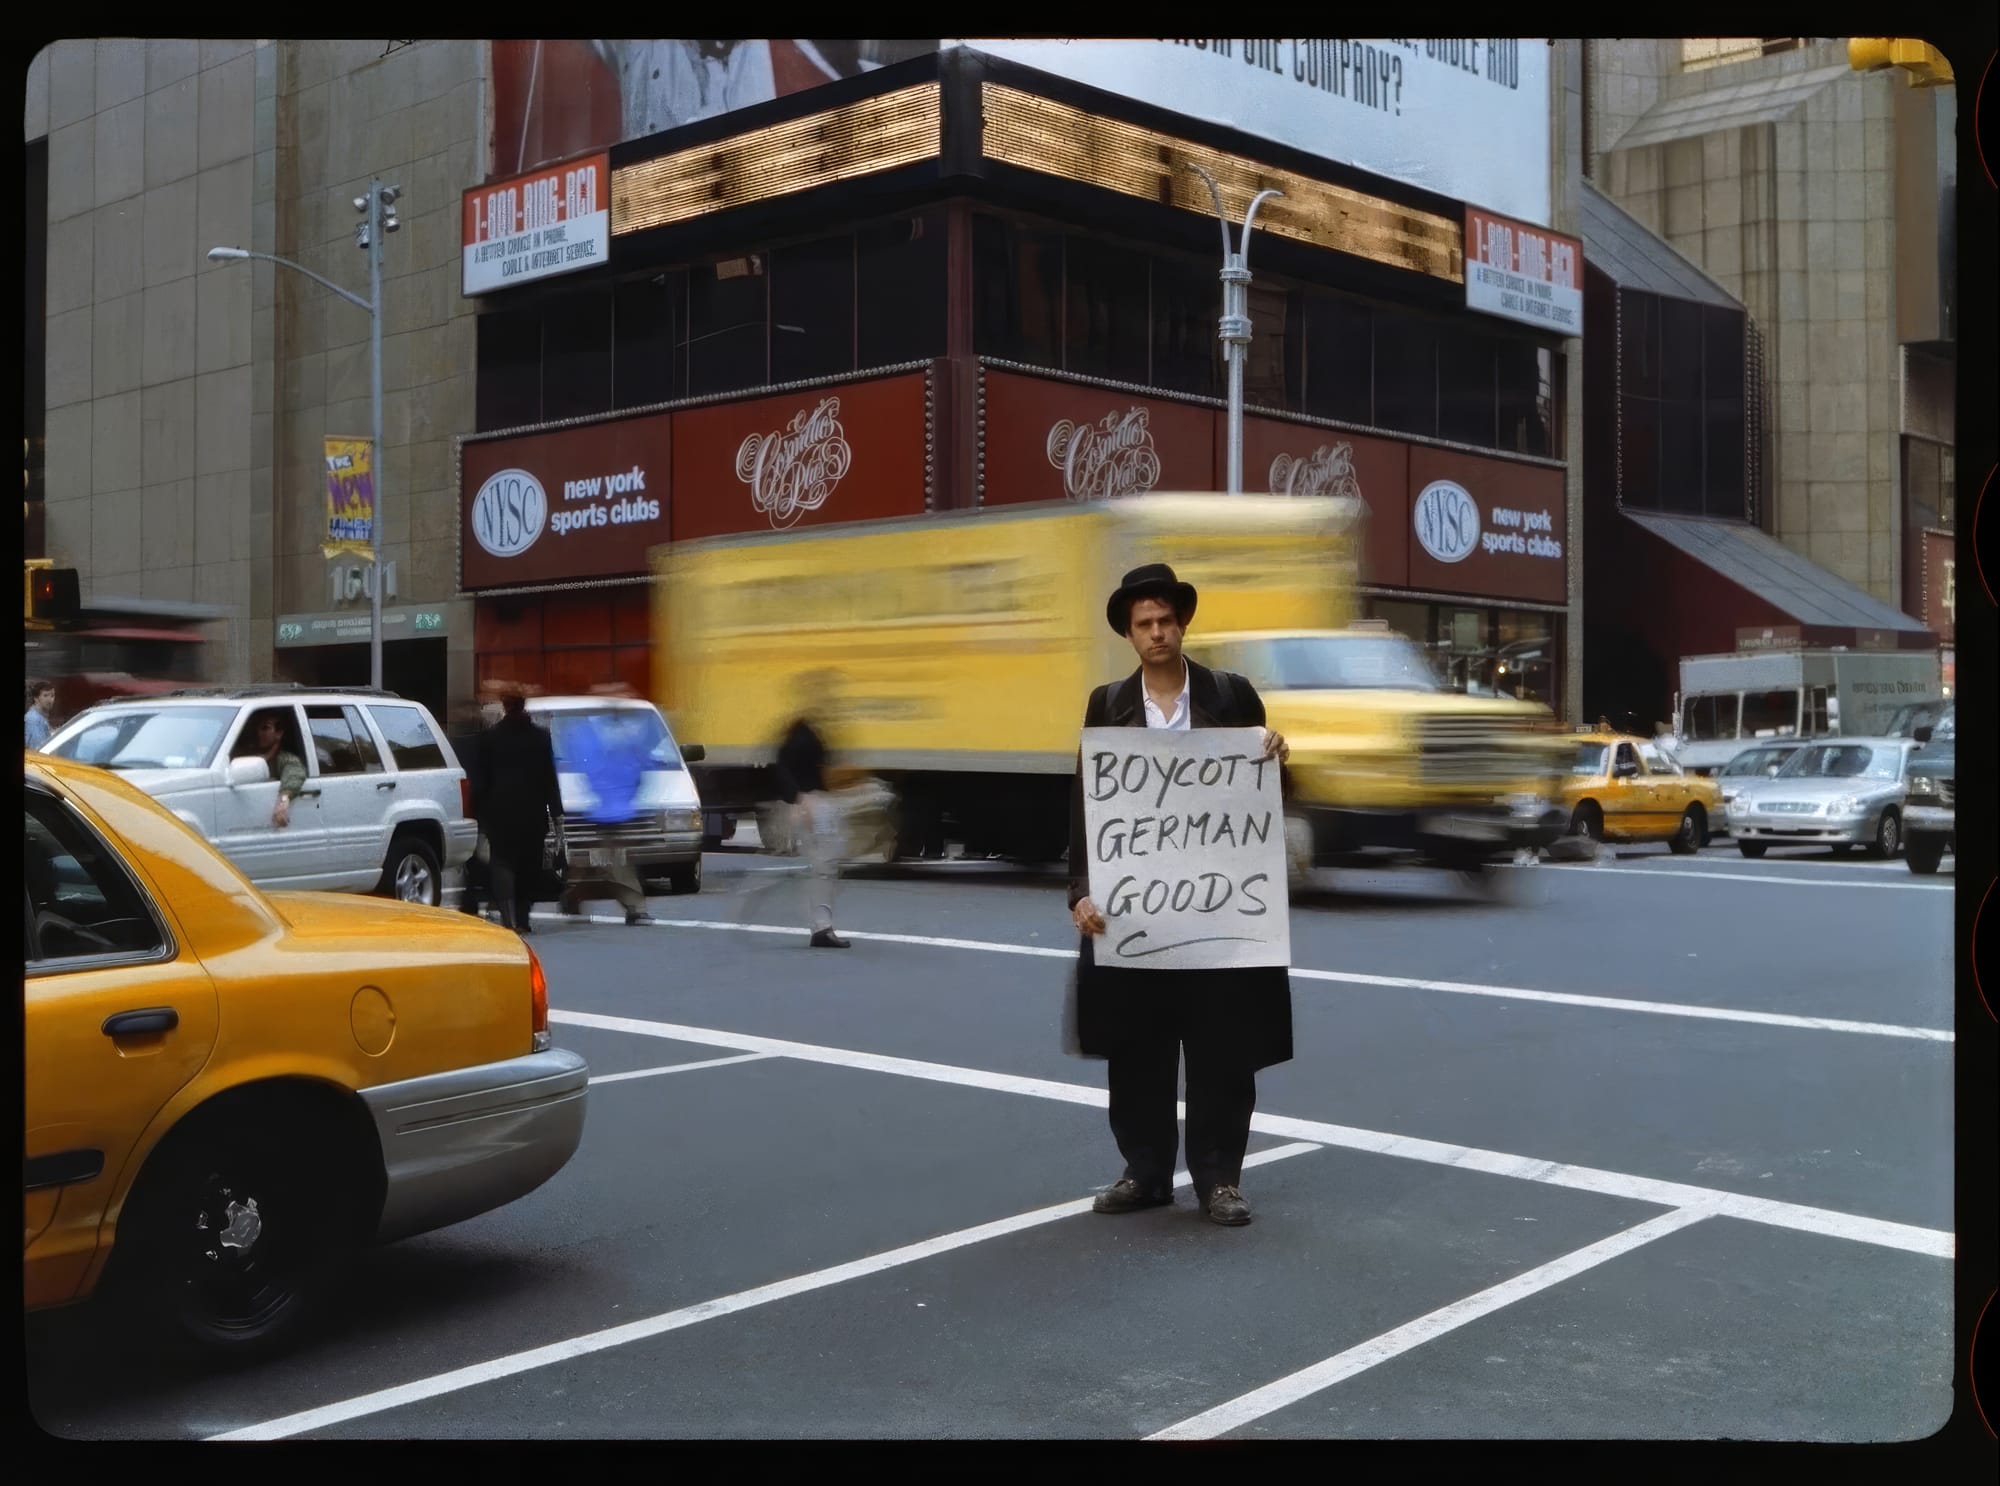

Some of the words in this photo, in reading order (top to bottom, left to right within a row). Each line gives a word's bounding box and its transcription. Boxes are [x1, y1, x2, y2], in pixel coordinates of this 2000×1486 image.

[1293, 39, 1403, 116] COMPANY?
[564, 476, 602, 500] new
[604, 465, 646, 500] york
[482, 479, 537, 548] NYSC
[551, 503, 608, 536] sports
[610, 496, 660, 524] clubs
[1423, 488, 1473, 553] NYSC
[1492, 507, 1521, 528] new
[1523, 509, 1553, 533] york
[1482, 531, 1526, 555] sports
[1527, 534, 1562, 559] clubs
[1088, 751, 1276, 809] BOYCOTT
[1096, 810, 1272, 863] GERMAN
[1106, 872, 1269, 918] GOODS
